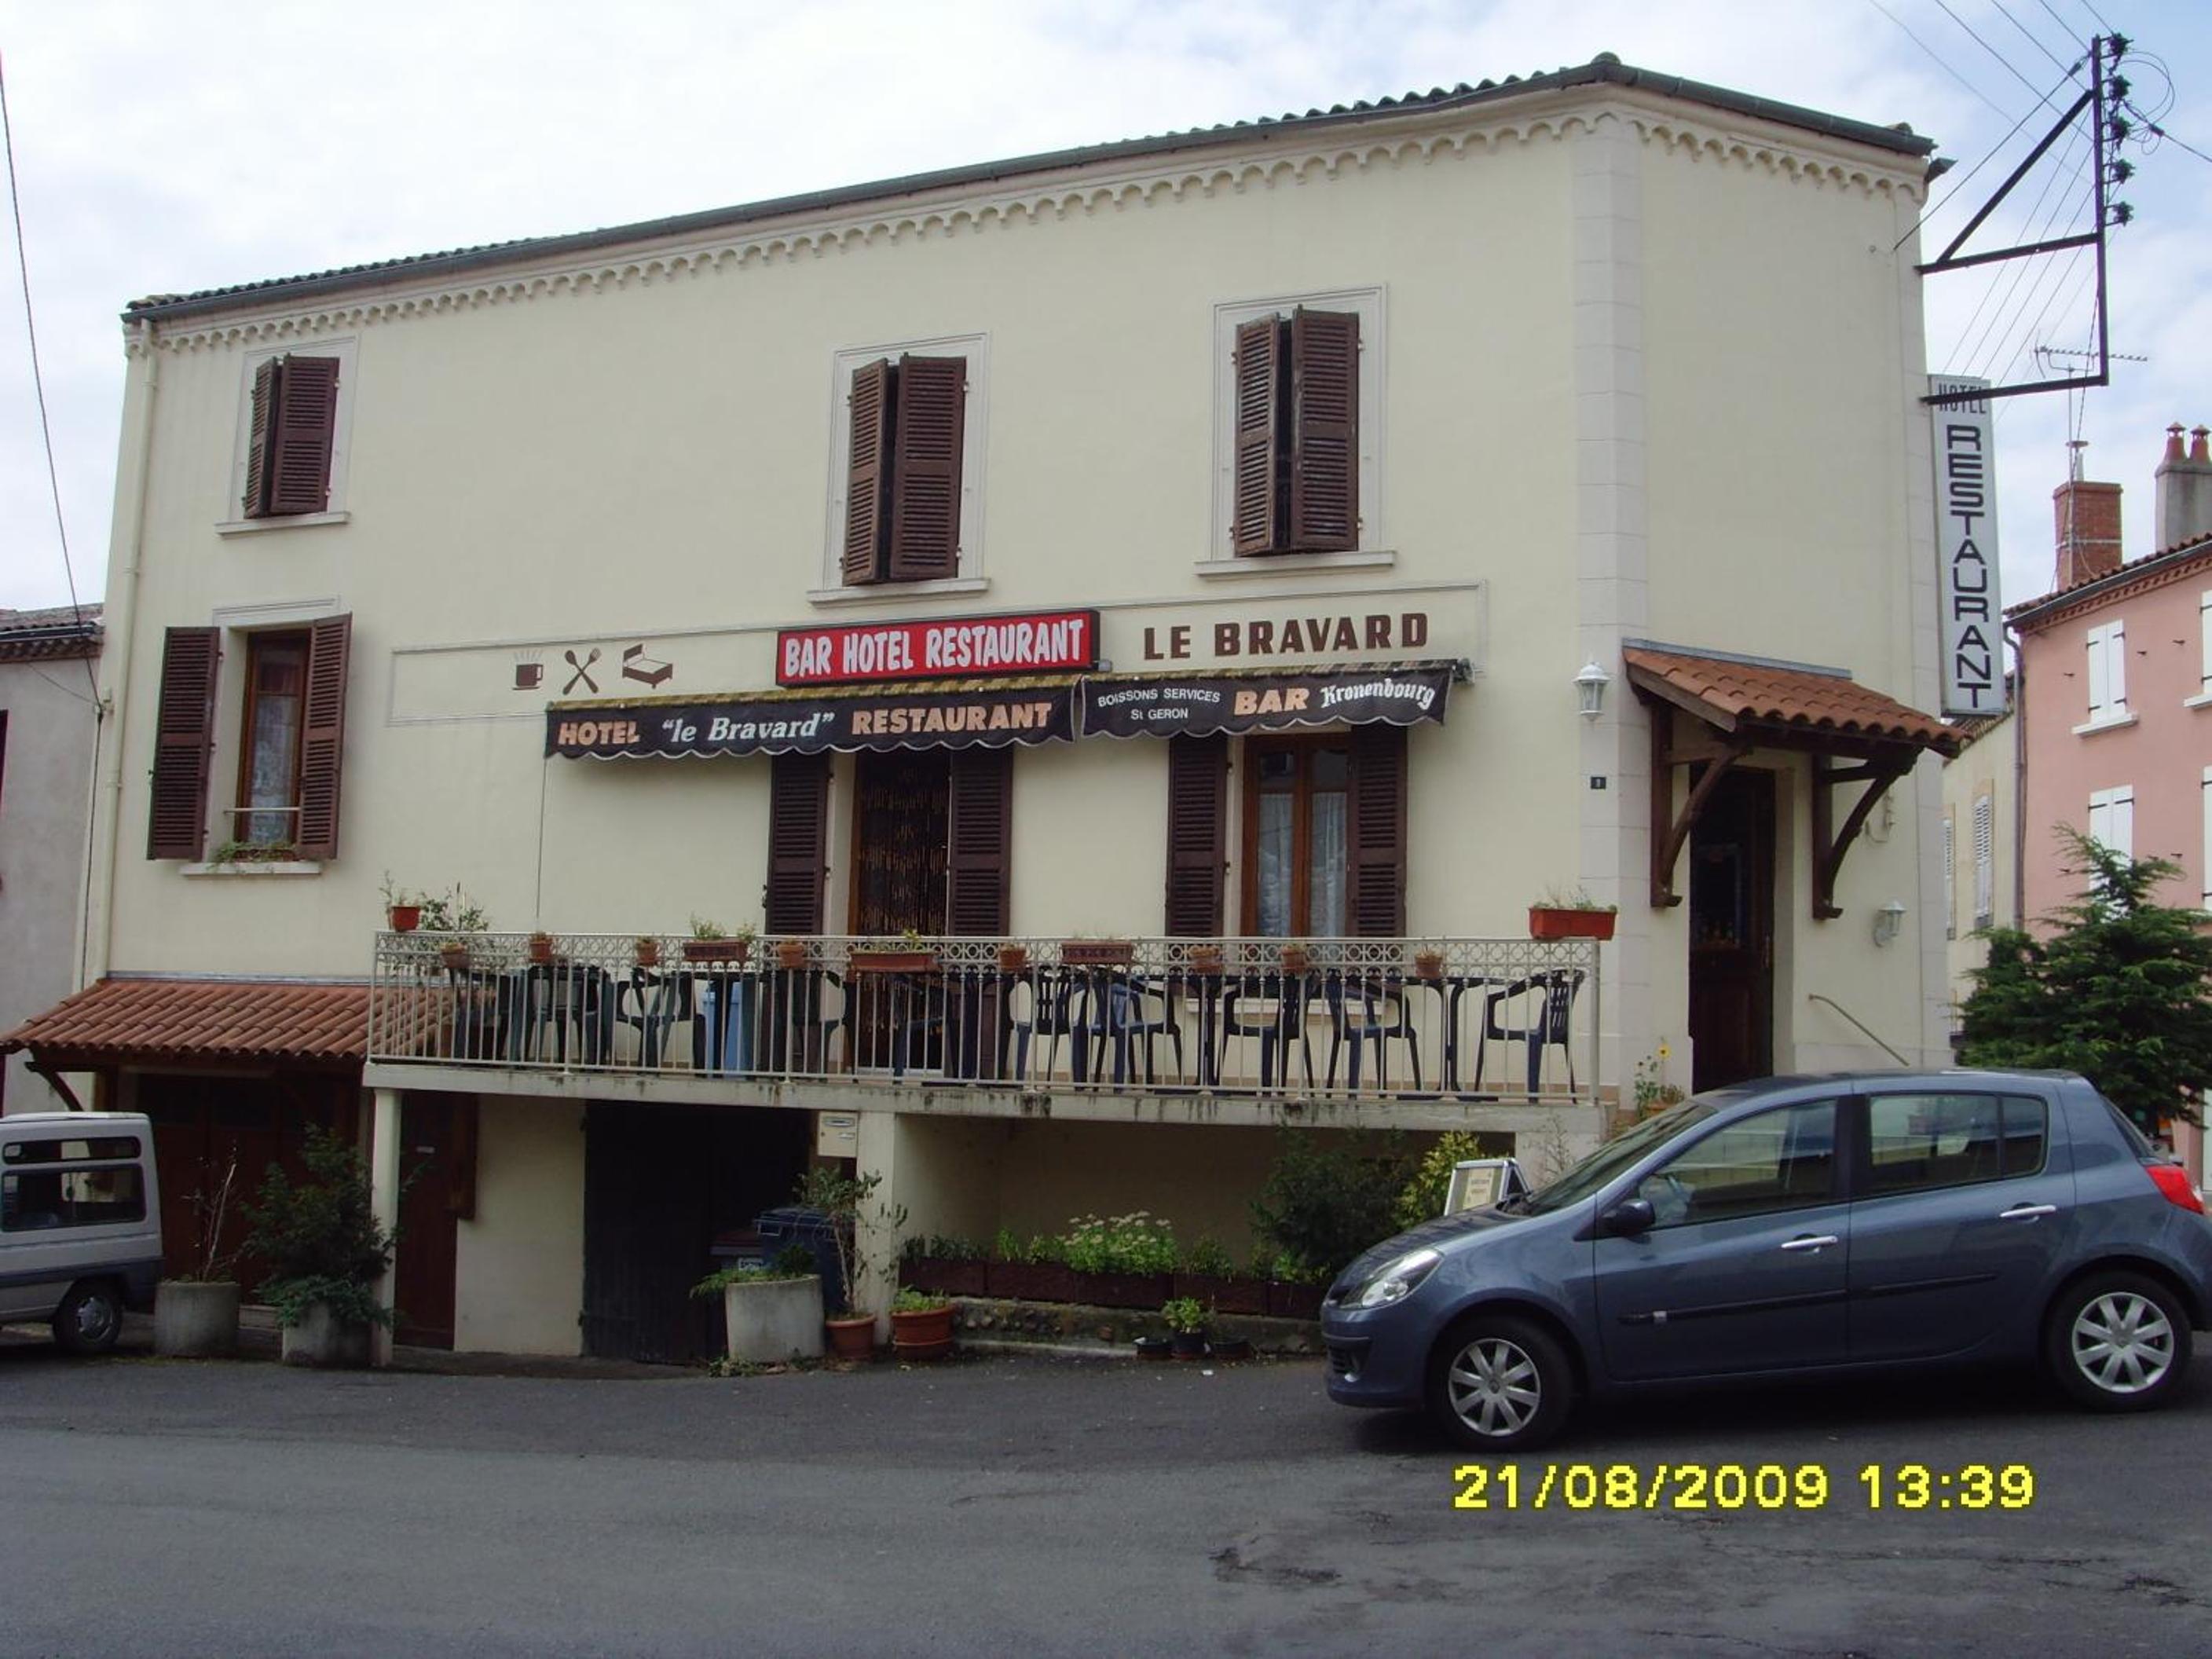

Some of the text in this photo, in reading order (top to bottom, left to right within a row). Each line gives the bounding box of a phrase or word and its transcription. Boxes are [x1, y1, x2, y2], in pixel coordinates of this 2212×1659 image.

[1938, 383, 1987, 414] HOTEL
[1946, 424, 1992, 709] RESTAURANT
[786, 619, 1084, 677] BAR HOTEL RESTAURANT
[1144, 613, 1428, 660] LE BRAVARD
[1130, 707, 1188, 720] St GERON
[1163, 687, 1221, 703] SERVICES
[1233, 678, 1436, 716] BAR Kronenbourg
[557, 721, 641, 745] HOTEL
[851, 702, 1053, 735] RESTAURANT
